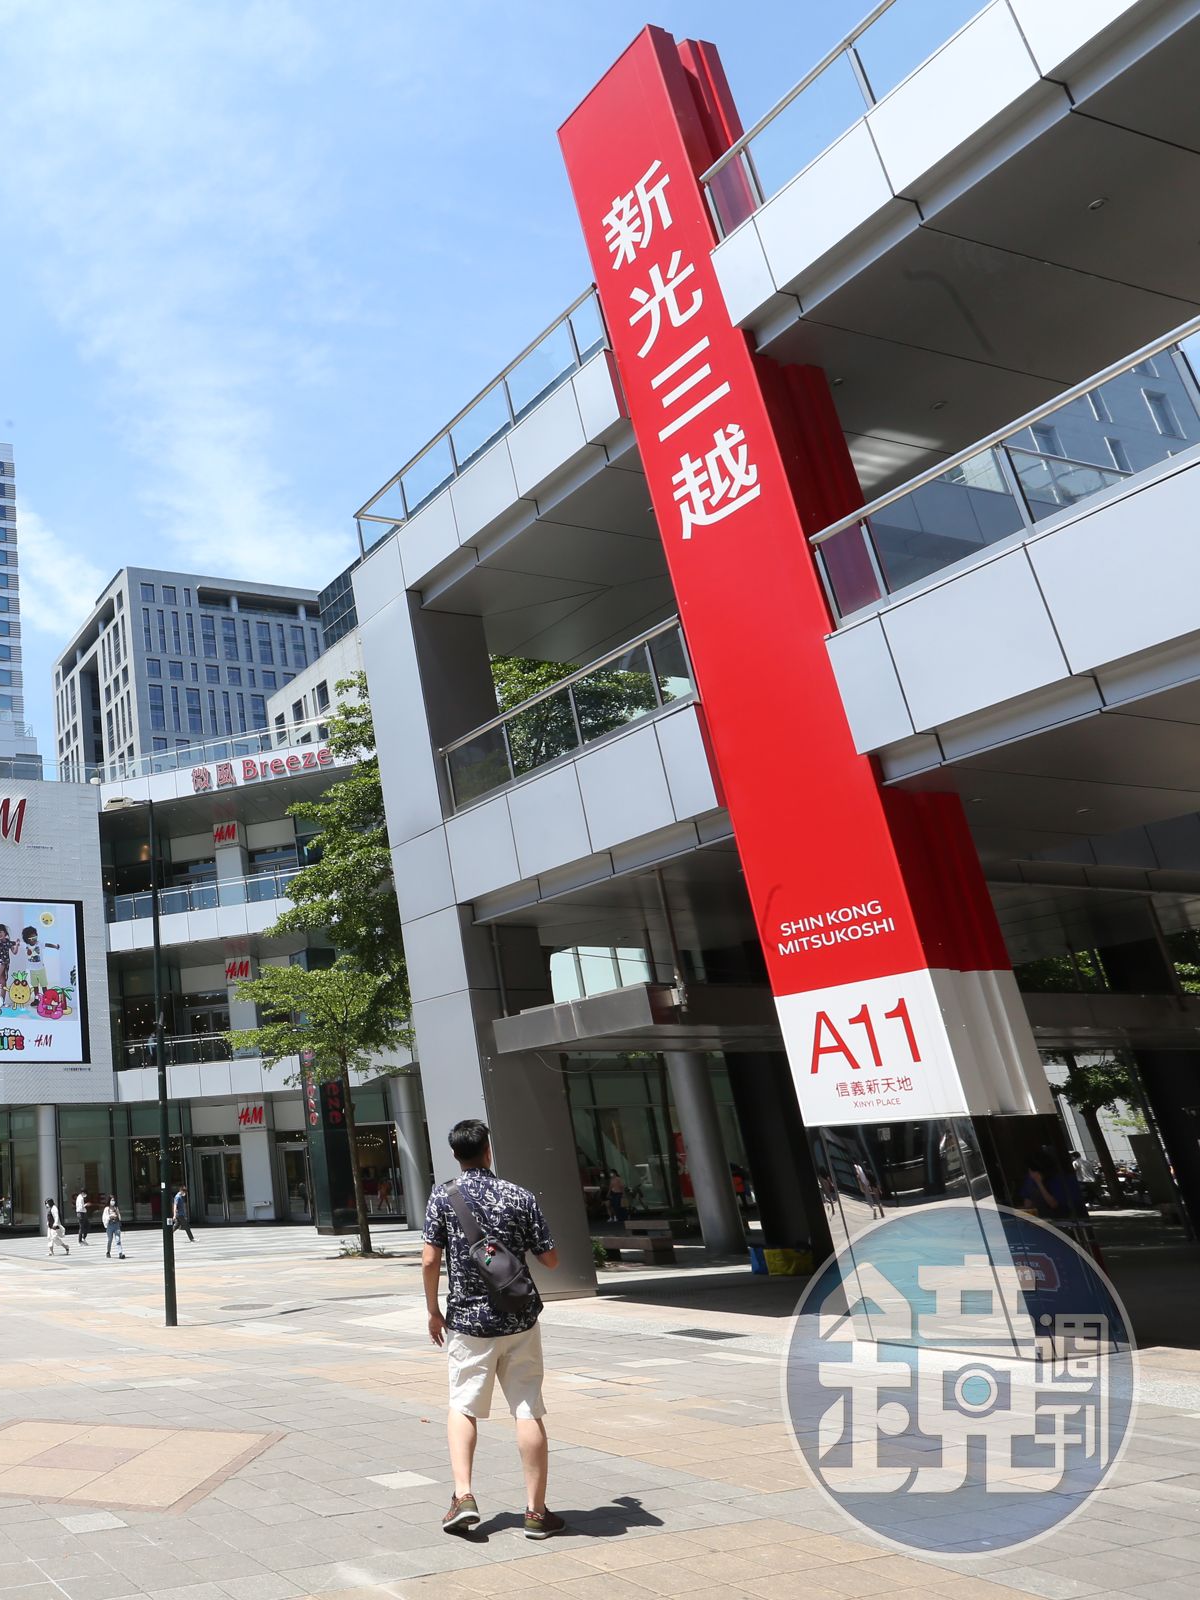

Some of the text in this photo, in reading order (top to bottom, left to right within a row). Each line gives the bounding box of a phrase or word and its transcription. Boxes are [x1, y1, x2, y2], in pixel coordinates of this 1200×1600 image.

[601, 158, 761, 540] 新光三越
[242, 748, 332, 780] Breeze
[213, 823, 236, 843] H&M
[779, 900, 882, 937] SHIN KONG
[777, 917, 895, 956] MITSUKOSHI
[225, 959, 249, 979] H&M
[34, 1034, 52, 1047] H&M
[810, 997, 921, 1075] A11
[835, 1076, 913, 1098] 信義新天地
[853, 1098, 901, 1109] XINYI PLACE
[238, 1105, 263, 1126] H&M
